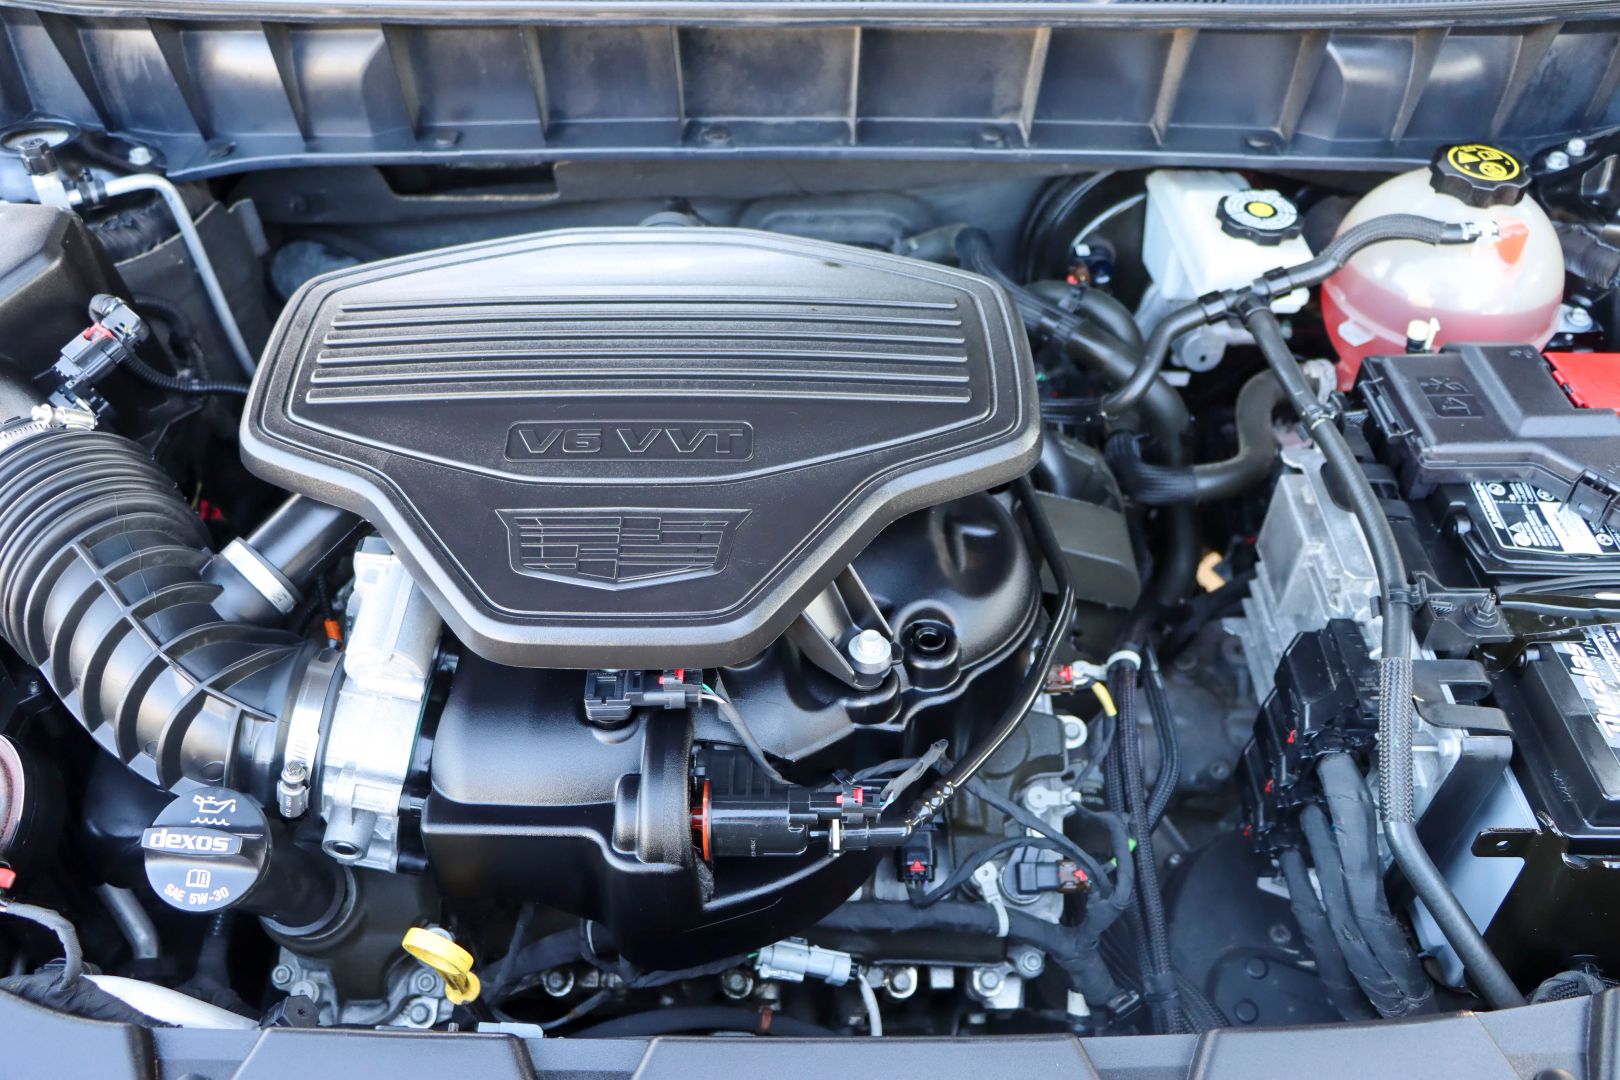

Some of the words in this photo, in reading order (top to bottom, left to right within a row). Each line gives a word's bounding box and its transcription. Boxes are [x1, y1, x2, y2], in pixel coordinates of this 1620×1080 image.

[518, 428, 602, 454] V6
[616, 428, 744, 454] VVT
[150, 828, 230, 852] dexos
[164, 883, 186, 902] SAE
[188, 886, 230, 905] 5W-30
